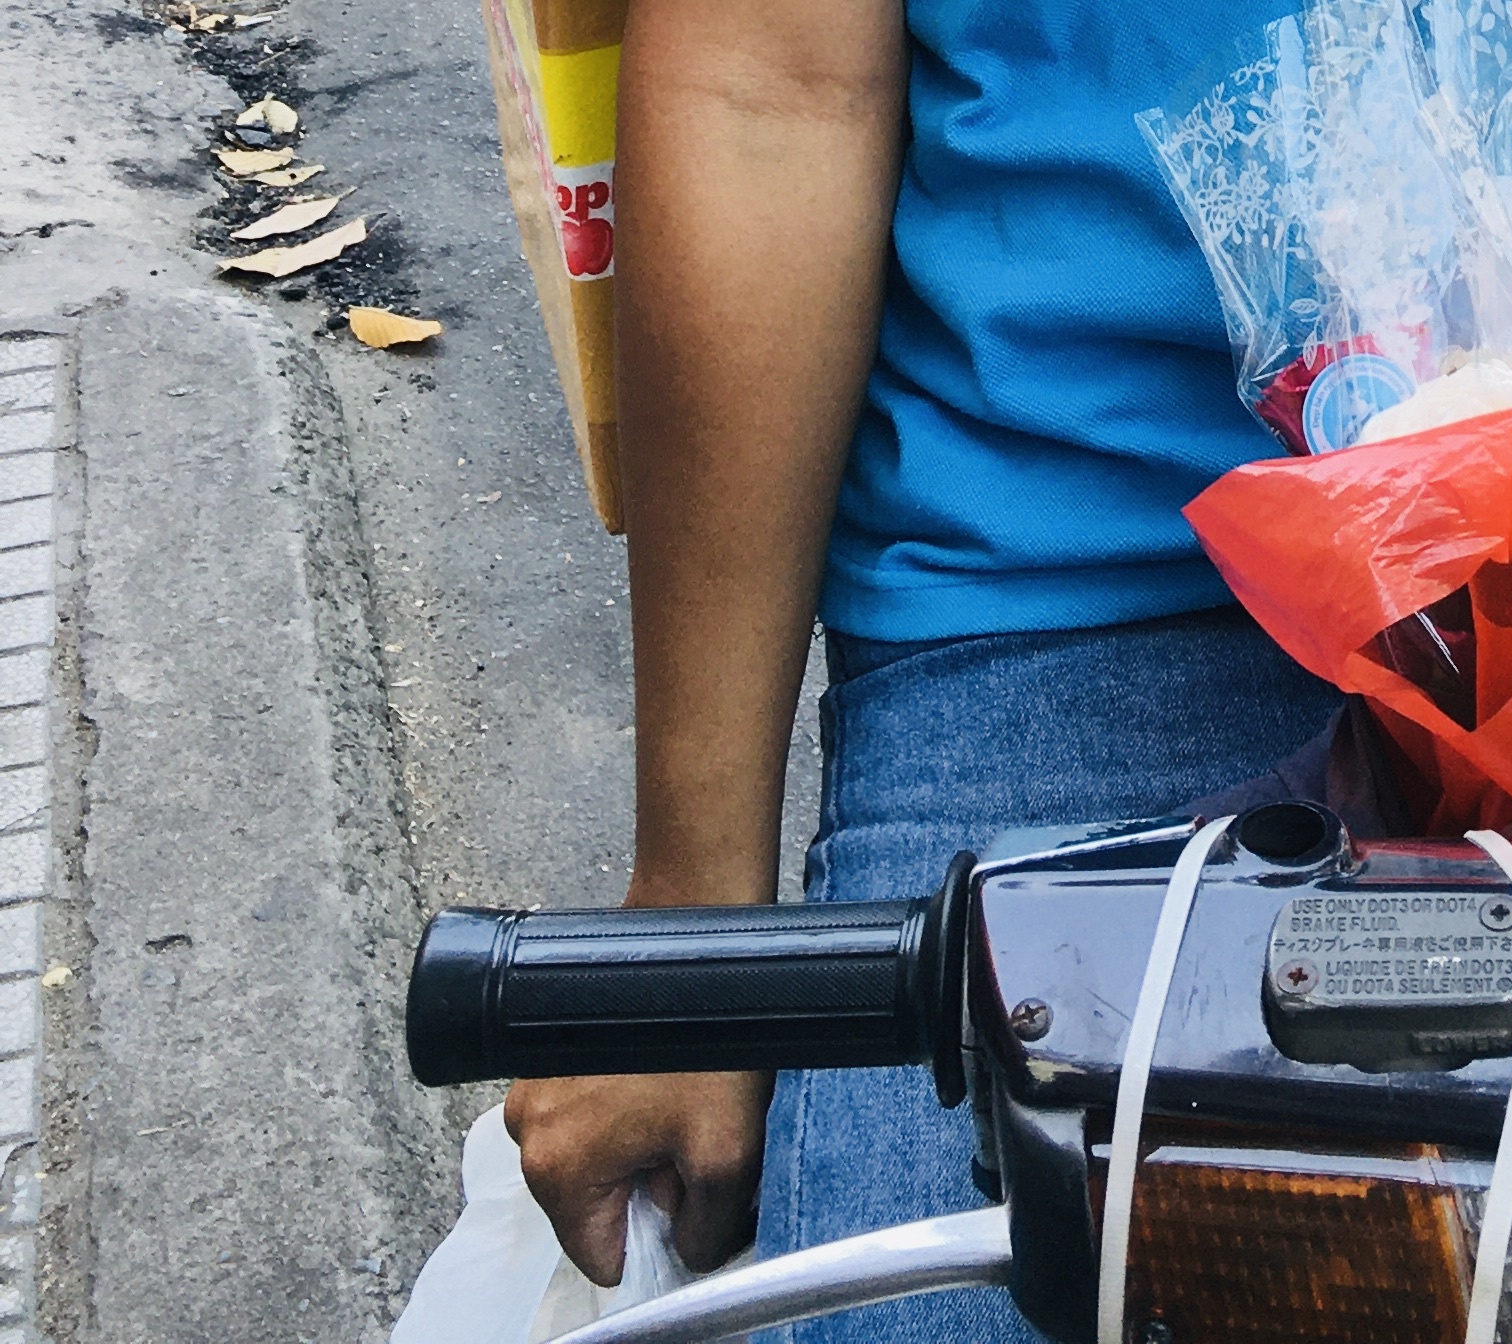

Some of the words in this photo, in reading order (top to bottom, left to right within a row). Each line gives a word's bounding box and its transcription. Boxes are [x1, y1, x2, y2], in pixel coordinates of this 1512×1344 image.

[1292, 898, 1323, 914] USE
[1325, 898, 1366, 914] ONLY
[1367, 898, 1409, 914] DOT3
[1410, 897, 1432, 913] OR
[1435, 897, 1477, 913] DOT4
[1290, 916, 1347, 932] BRAKE
[1325, 960, 1391, 976] LIQUIDE
[1394, 959, 1416, 976] DE
[1325, 978, 1349, 994] OU
[1352, 978, 1394, 994] DOT4
